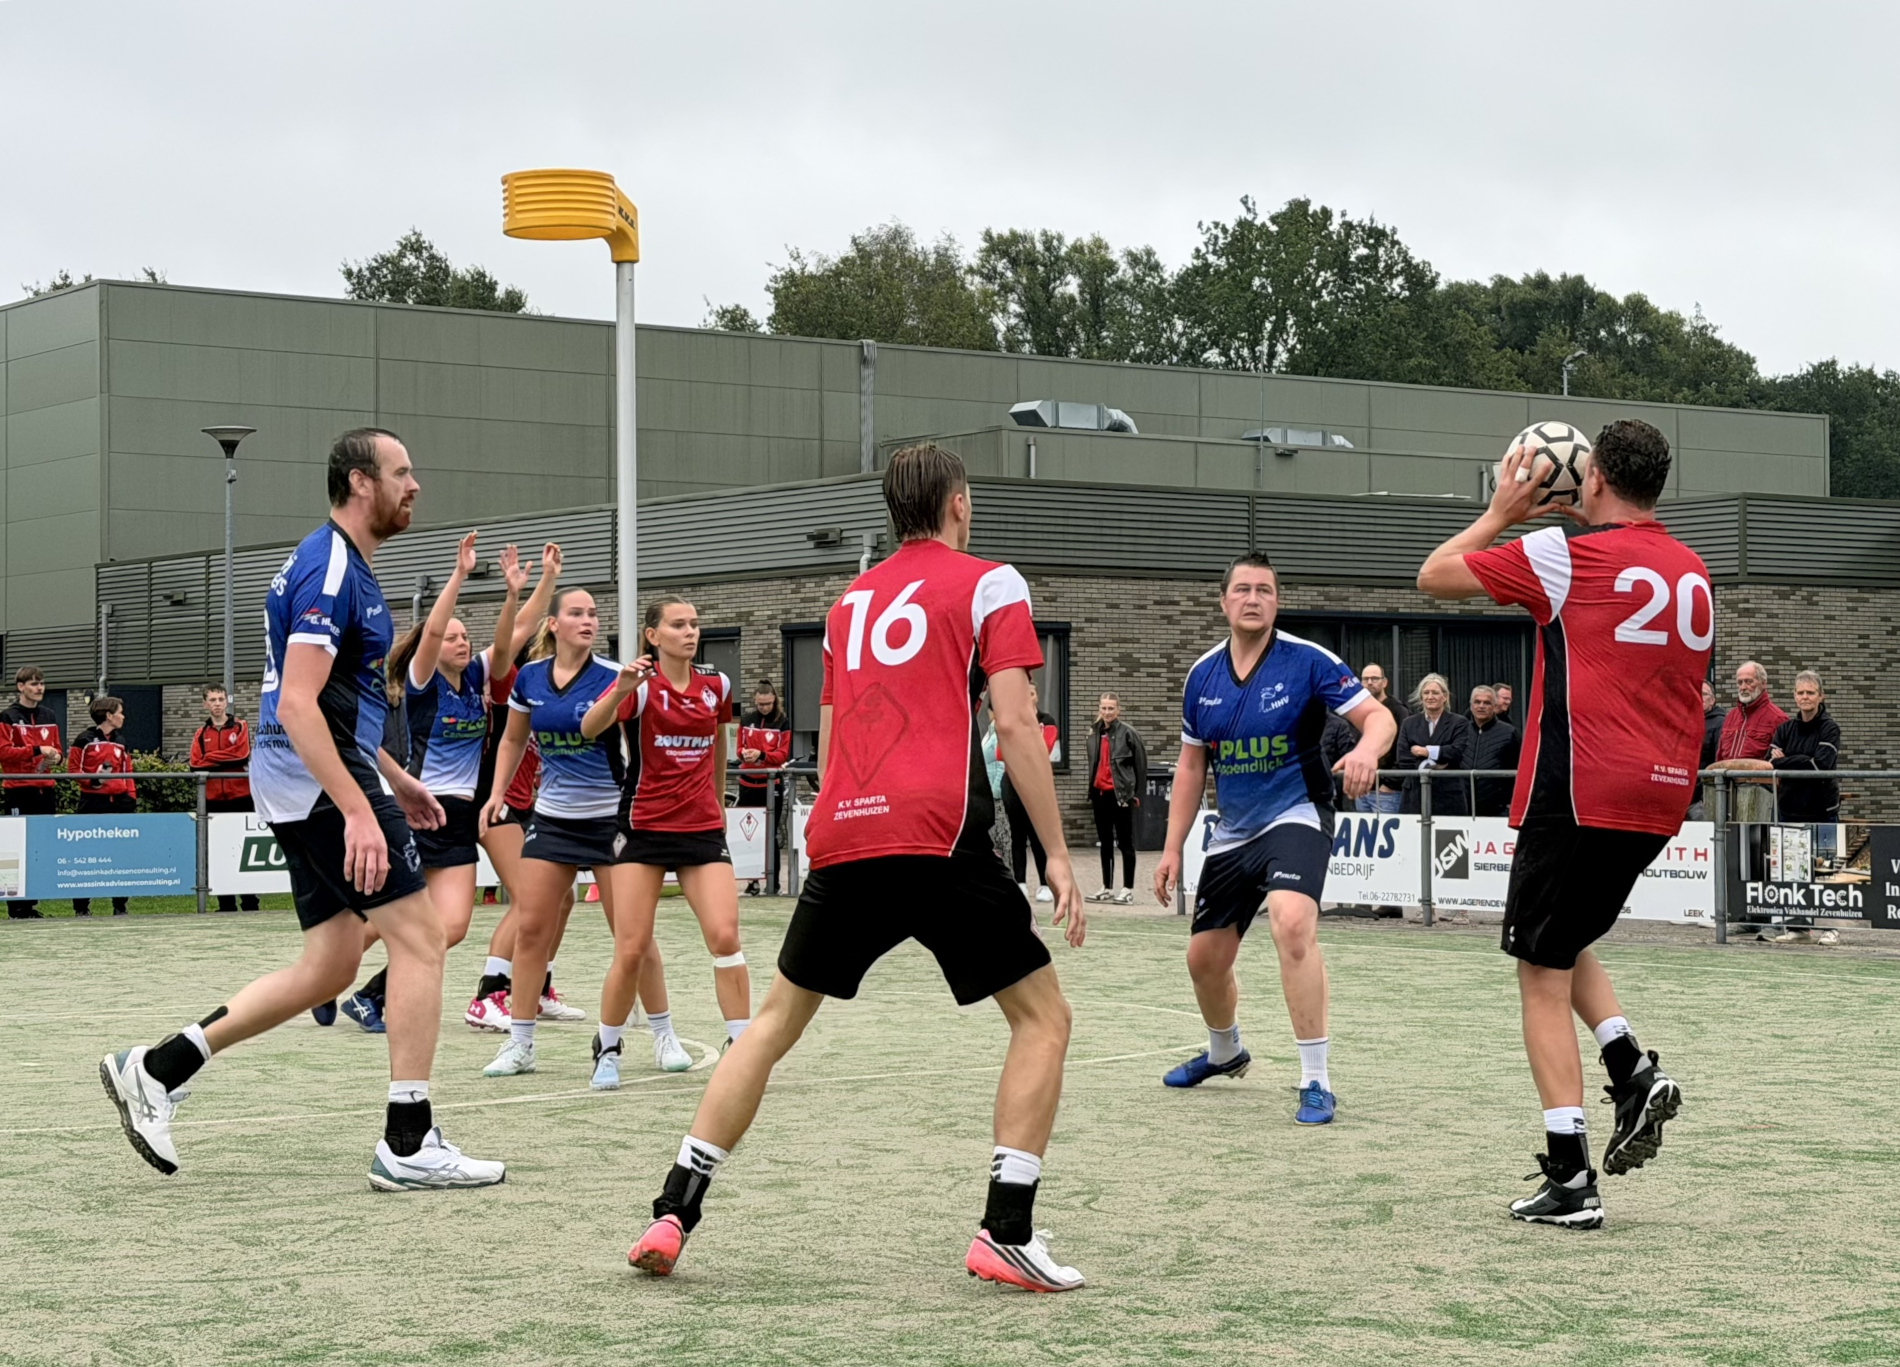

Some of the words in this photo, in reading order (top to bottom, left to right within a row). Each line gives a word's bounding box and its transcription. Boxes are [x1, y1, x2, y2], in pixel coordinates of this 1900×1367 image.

[1614, 566, 1714, 652] 20
[841, 579, 927, 671] 16
[659, 689, 669, 711] 1
[1220, 735, 1289, 760] PLUS
[838, 800, 852, 809] K.V.
[854, 795, 886, 806] SPARTA
[833, 805, 890, 821] ZEVENHUIZEN
[57, 827, 139, 841] Hypotheken
[1809, 884, 1863, 907] Tech
[1684, 909, 1704, 918] LEEK
[1747, 905, 1783, 915] Elektronica
[1785, 907, 1819, 916] Vakhandel
[1820, 908, 1863, 918] Zevenhuizen
